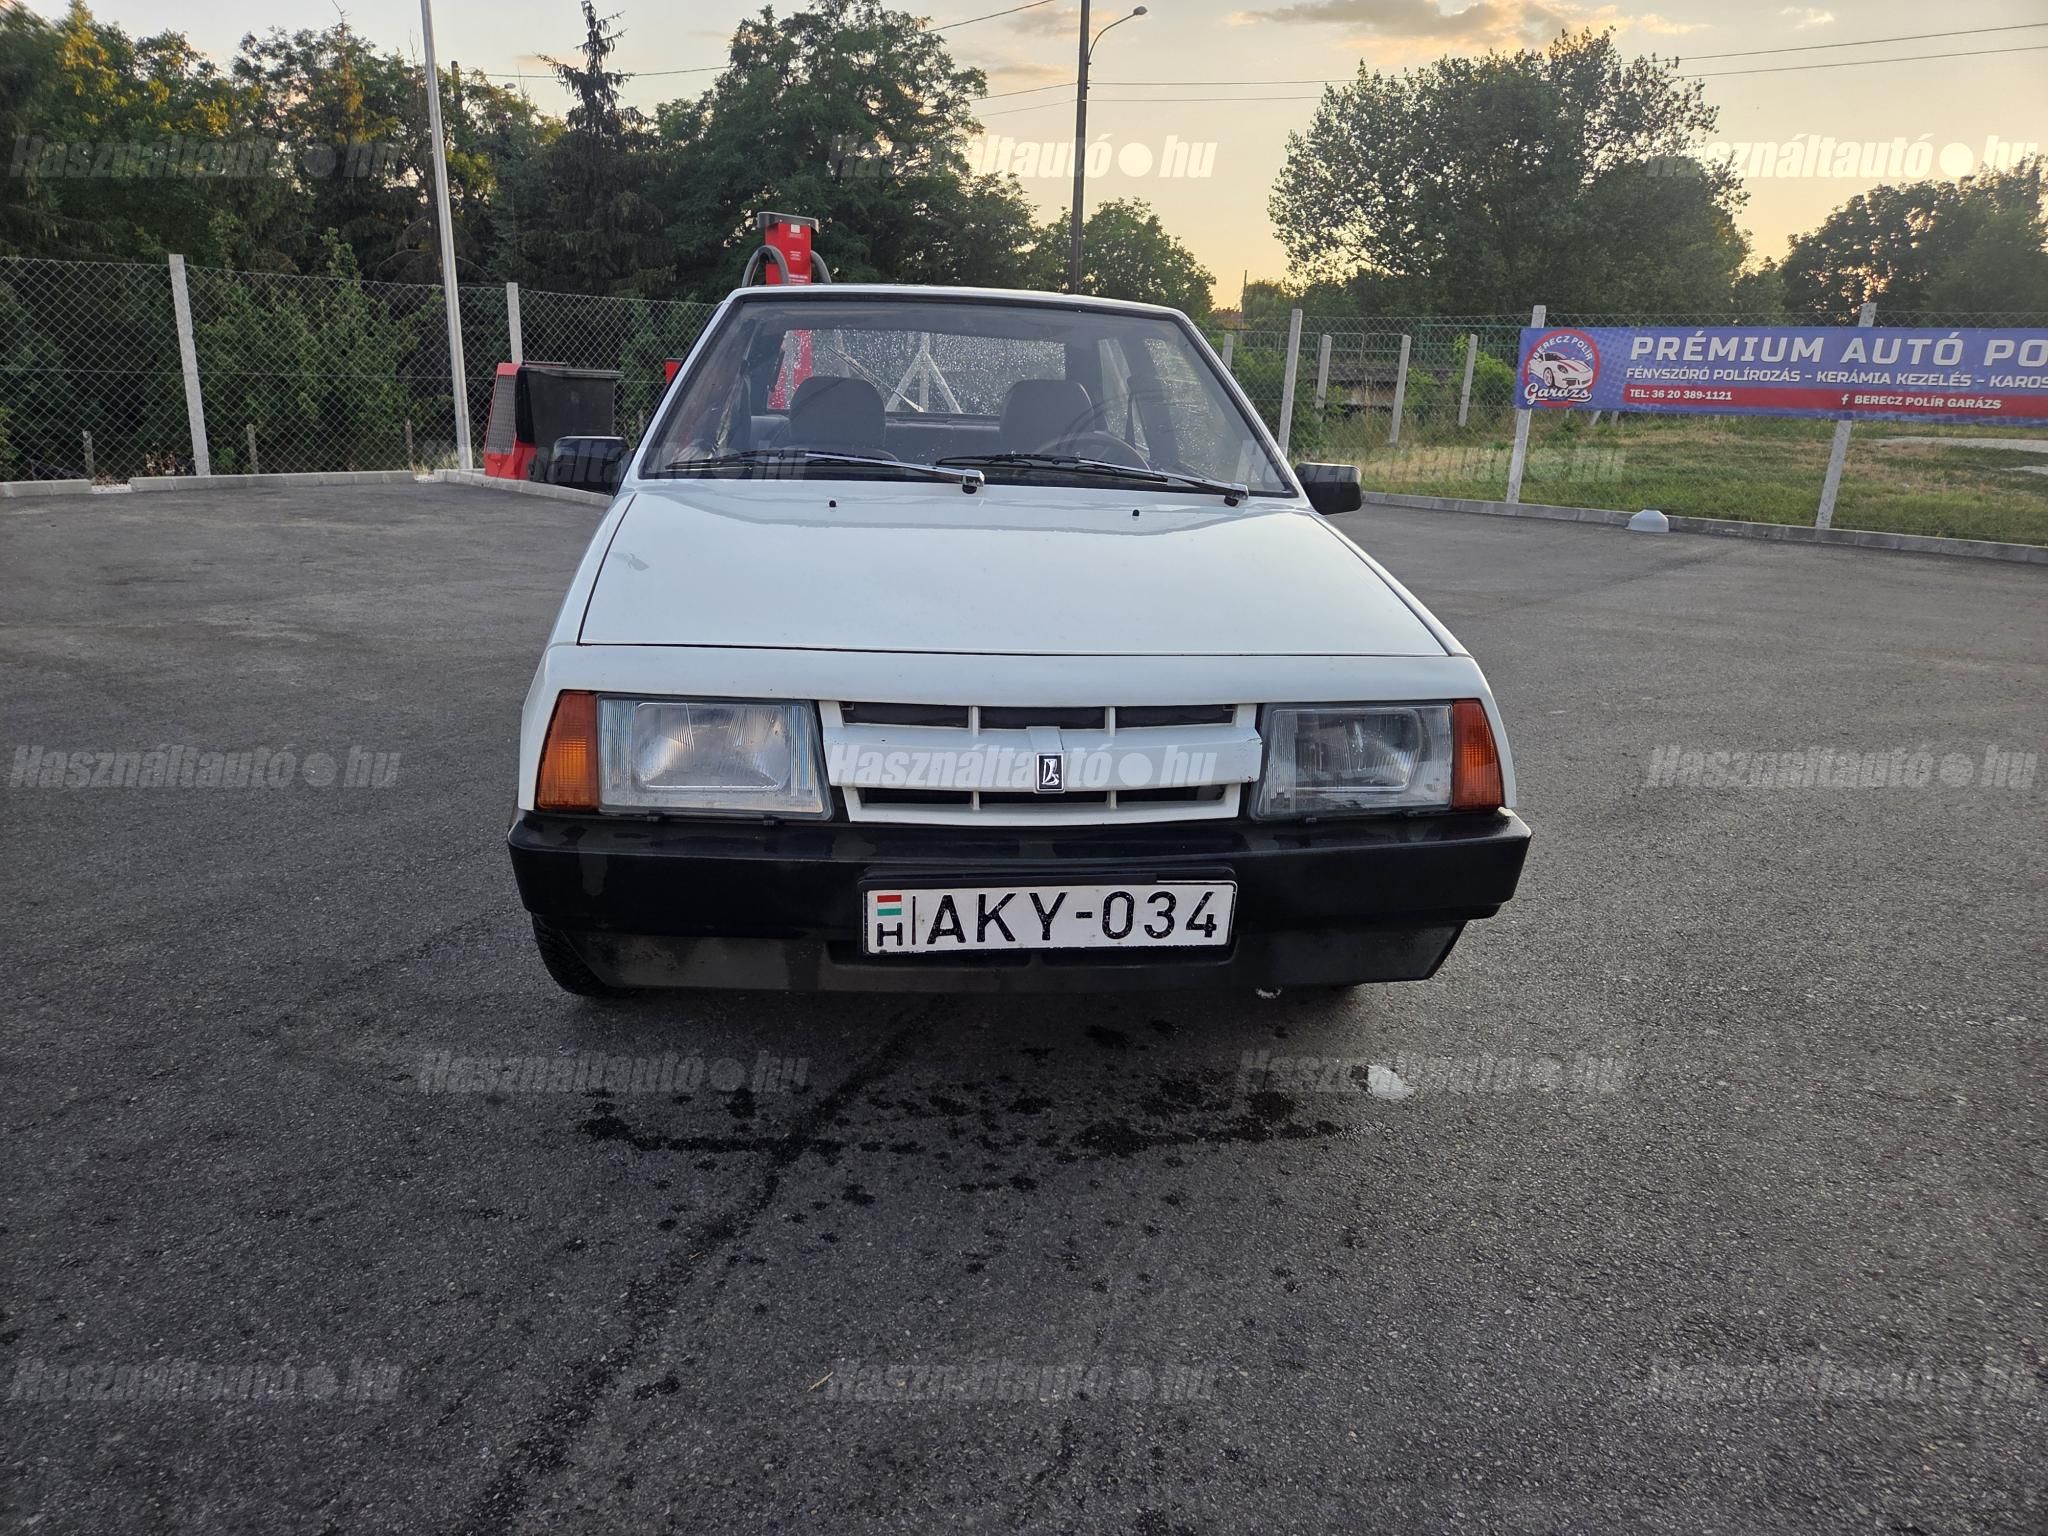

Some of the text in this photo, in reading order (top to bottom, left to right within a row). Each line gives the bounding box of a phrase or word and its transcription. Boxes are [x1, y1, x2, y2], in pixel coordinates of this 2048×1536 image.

[1533, 336, 1570, 360] BERECZ
[1630, 331, 2048, 367] PRÉMIUM AUTÓ PO
[1626, 366, 1710, 381] FÉNYSZÓRÓ
[1713, 367, 1800, 382] POLÍROZÁS
[1816, 369, 1891, 385] KERÁMIA
[1896, 371, 1972, 387] KEZELÉS
[1630, 389, 1732, 401] TEL: 36 20 389-1121
[1854, 395, 1903, 406] BERECZ
[1905, 396, 1944, 408] POLÍR
[1947, 397, 2002, 410] GARÁZS
[926, 891, 1217, 945] AKY-034
[876, 922, 903, 947] H
